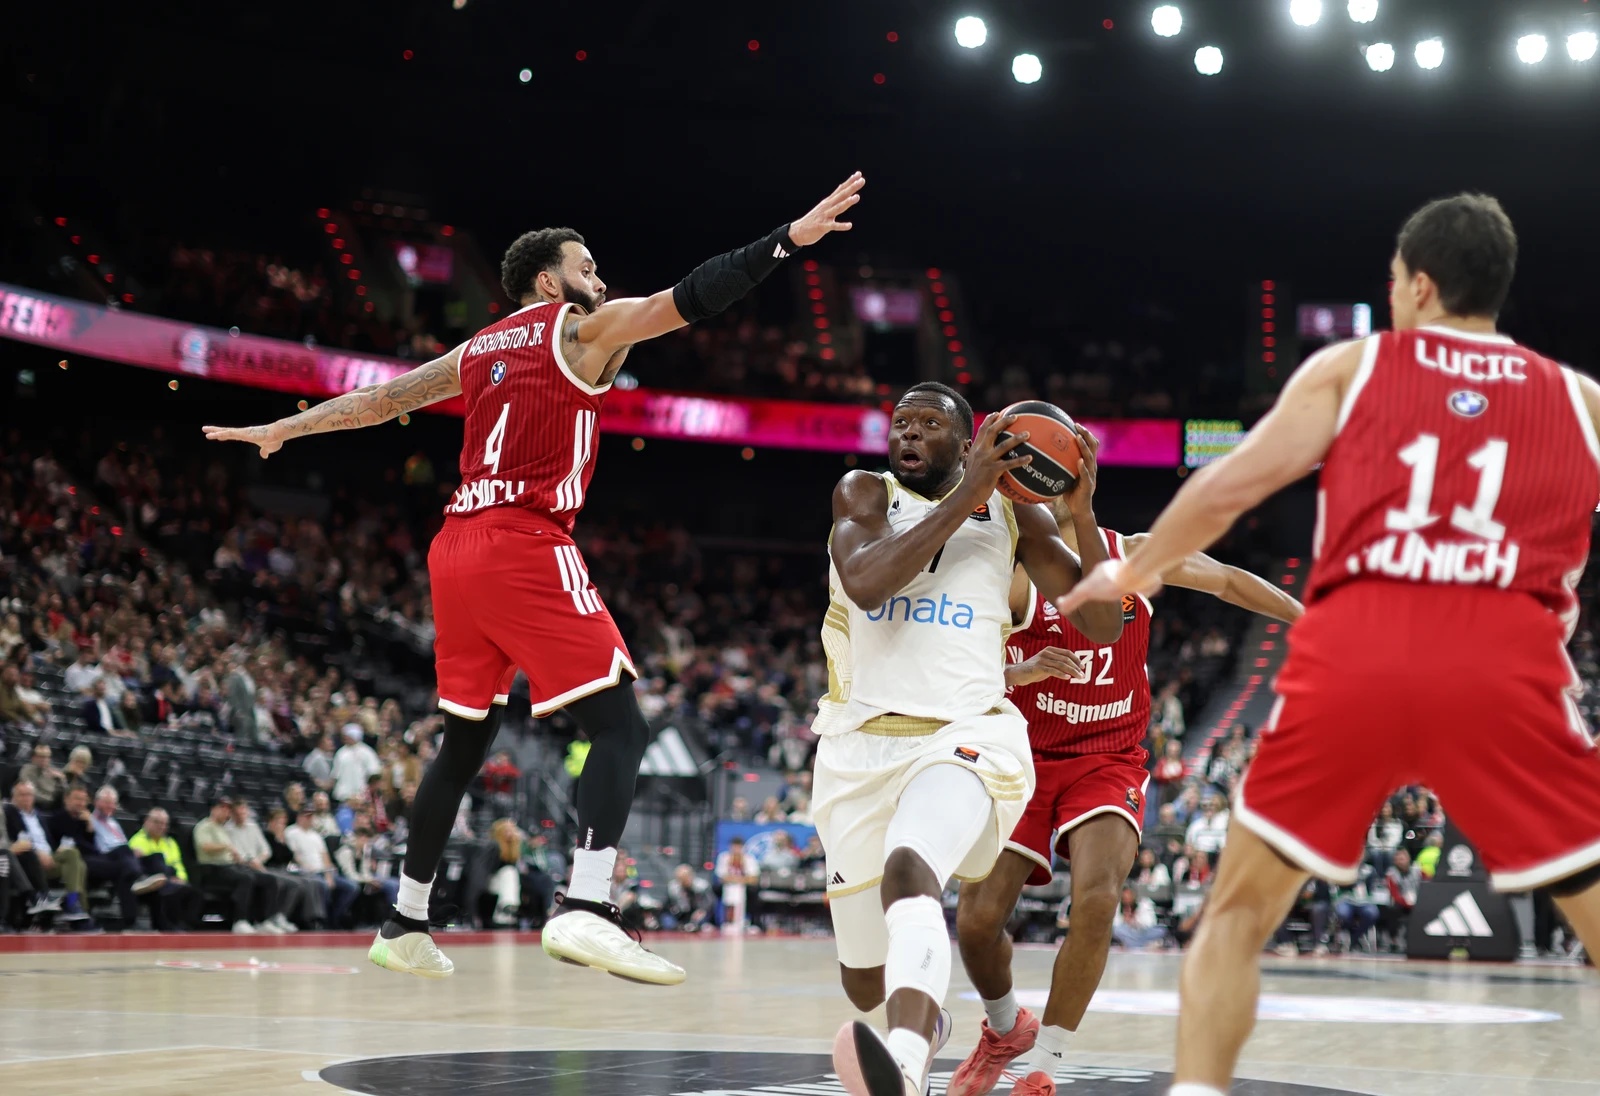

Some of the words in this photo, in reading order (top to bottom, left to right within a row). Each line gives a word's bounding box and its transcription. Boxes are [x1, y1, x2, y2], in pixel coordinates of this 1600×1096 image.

[467, 324, 530, 358] WASHINGTON
[528, 322, 546, 347] JR.
[1415, 338, 1528, 382] LUCIC
[483, 402, 510, 475] 4
[446, 479, 526, 513] UNICH
[1385, 432, 1509, 541] 11
[1069, 646, 1114, 686] 32
[1036, 689, 1135, 725] siegmund
[585, 826, 594, 850] ECHFIT
